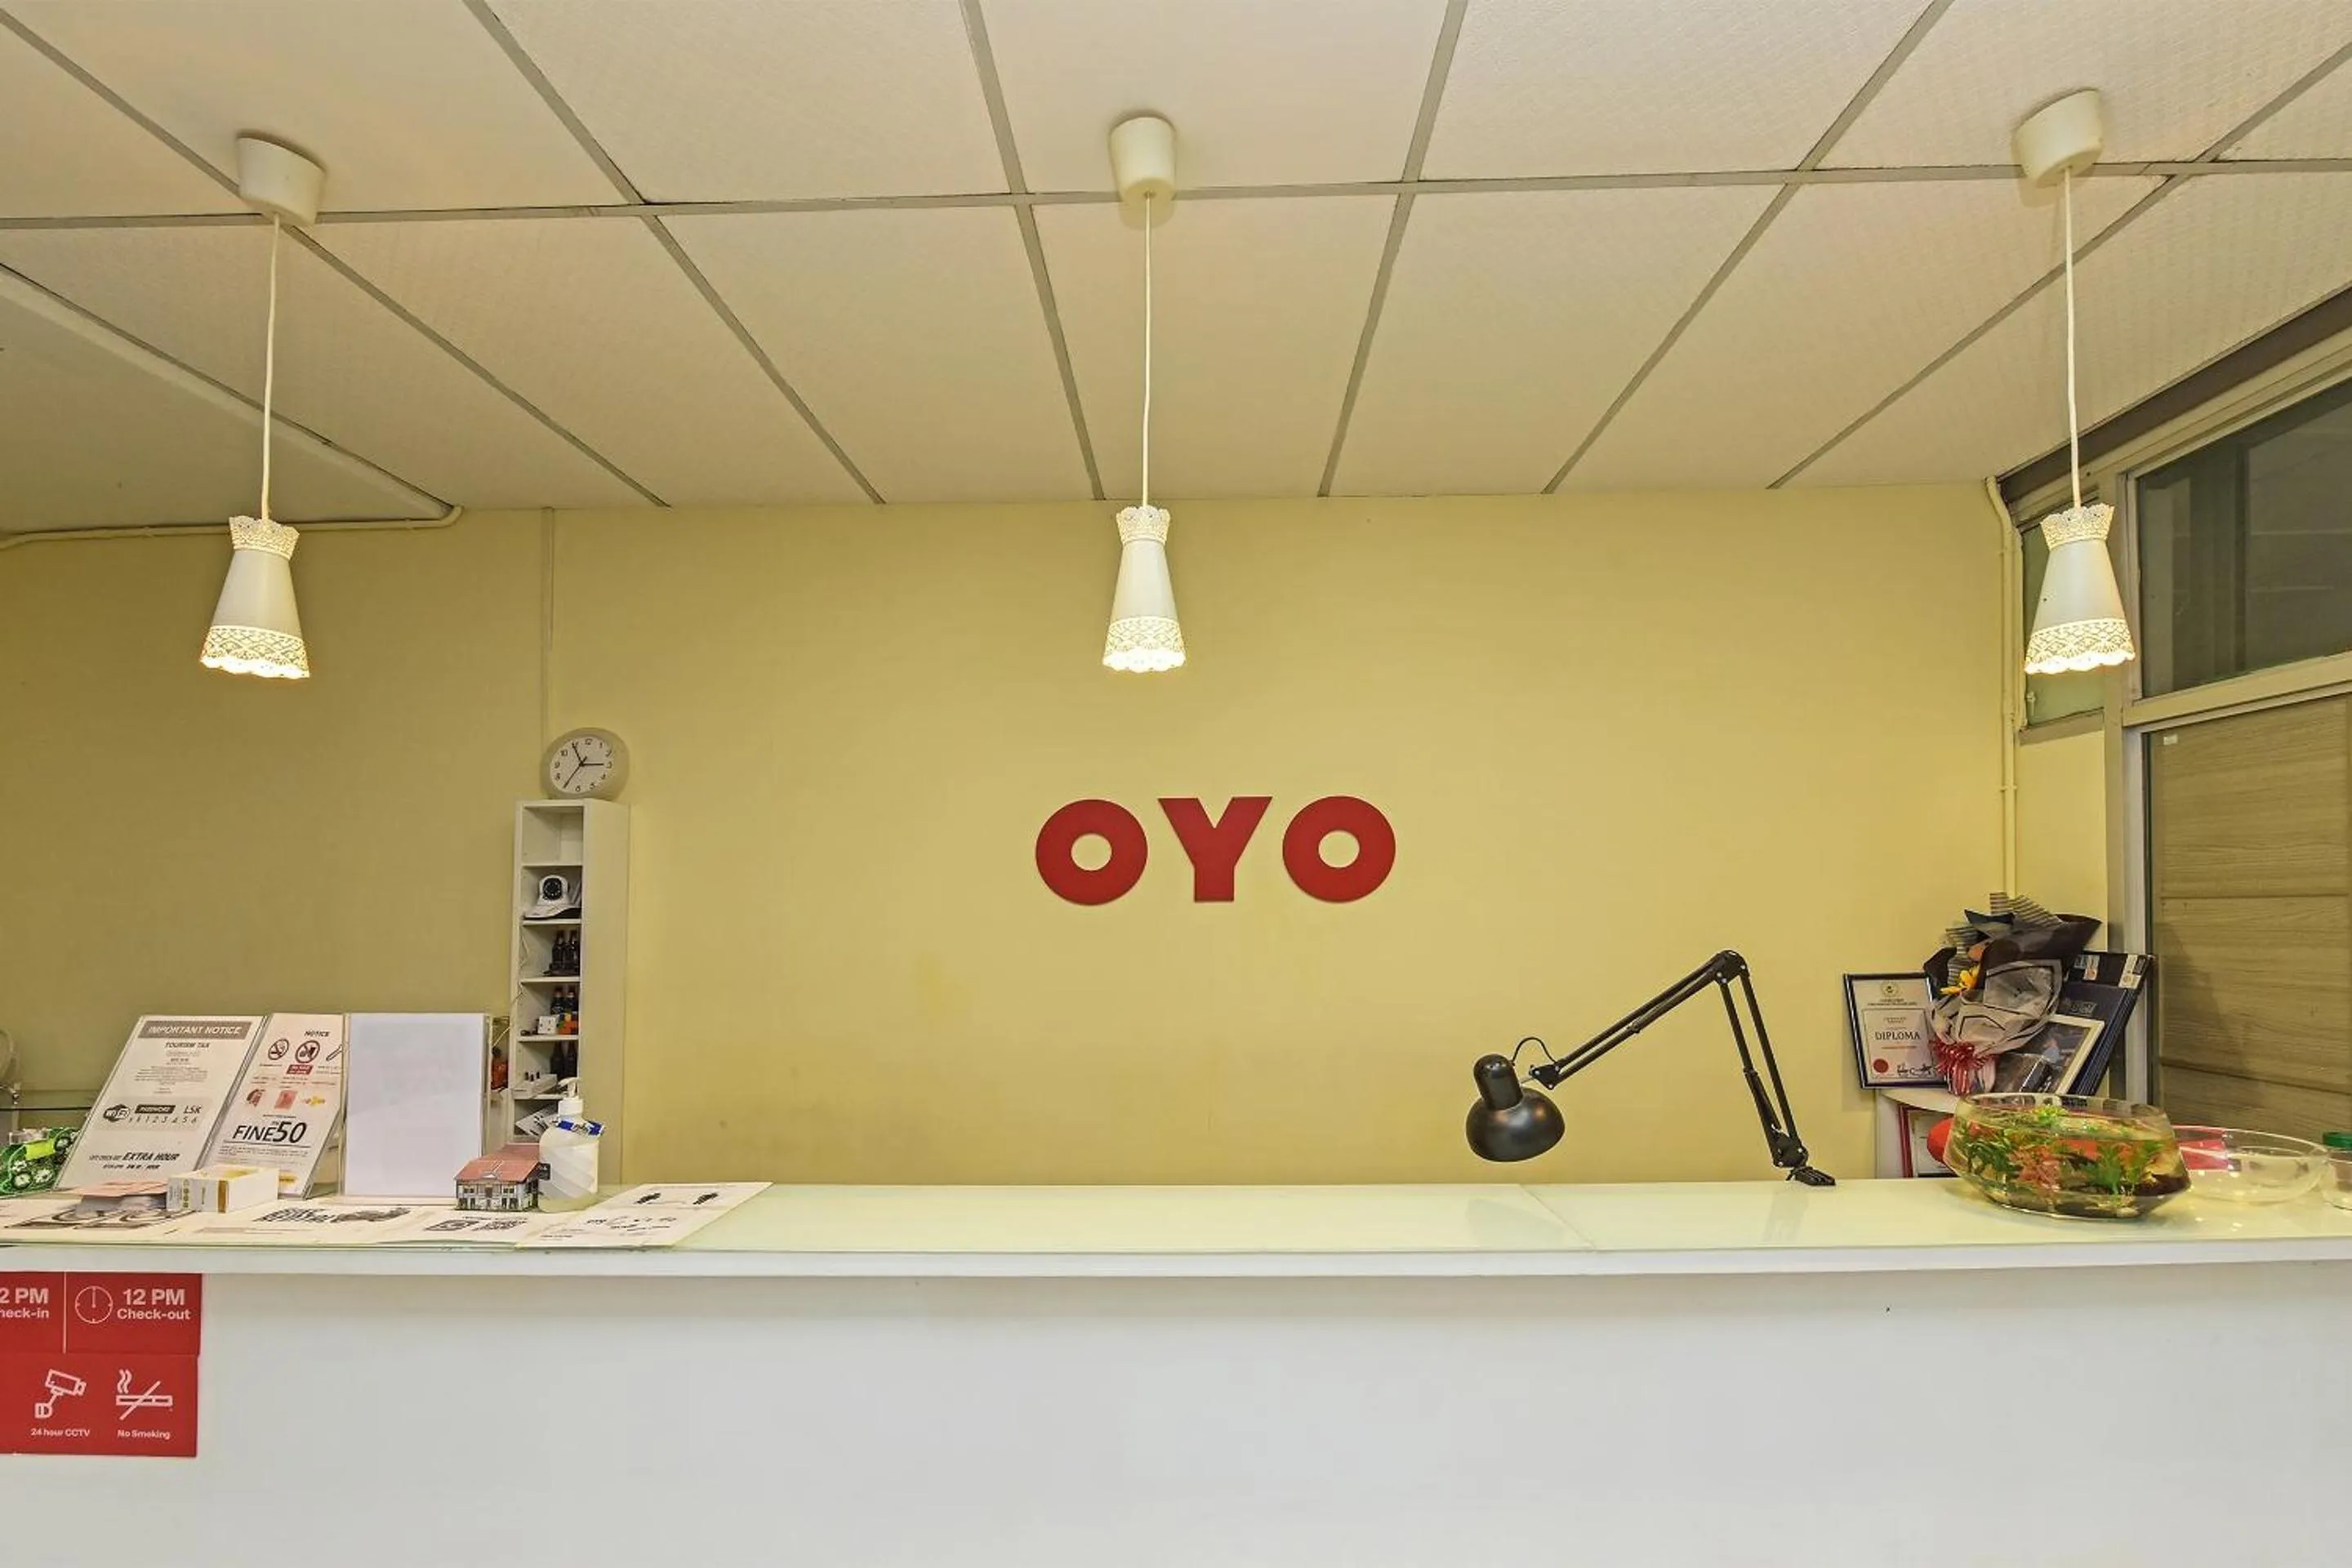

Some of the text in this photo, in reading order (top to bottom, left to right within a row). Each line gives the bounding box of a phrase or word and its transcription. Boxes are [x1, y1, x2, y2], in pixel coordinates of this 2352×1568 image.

[1035, 795, 1396, 906] OYO
[148, 1026, 242, 1035] IMPORTANT NOTICE
[1874, 1031, 1921, 1040] DIPLOMA
[232, 1121, 307, 1143] FINE 50
[122, 1152, 154, 1160] EXTRA
[154, 1152, 180, 1160] HOUR
[15, 1287, 49, 1304] PM
[123, 1289, 185, 1305] 12 PM
[117, 1308, 190, 1320] Check-out
[43, 1428, 63, 1437] hour
[65, 1429, 91, 1437] CCTV
[131, 1430, 171, 1441] Smoking
